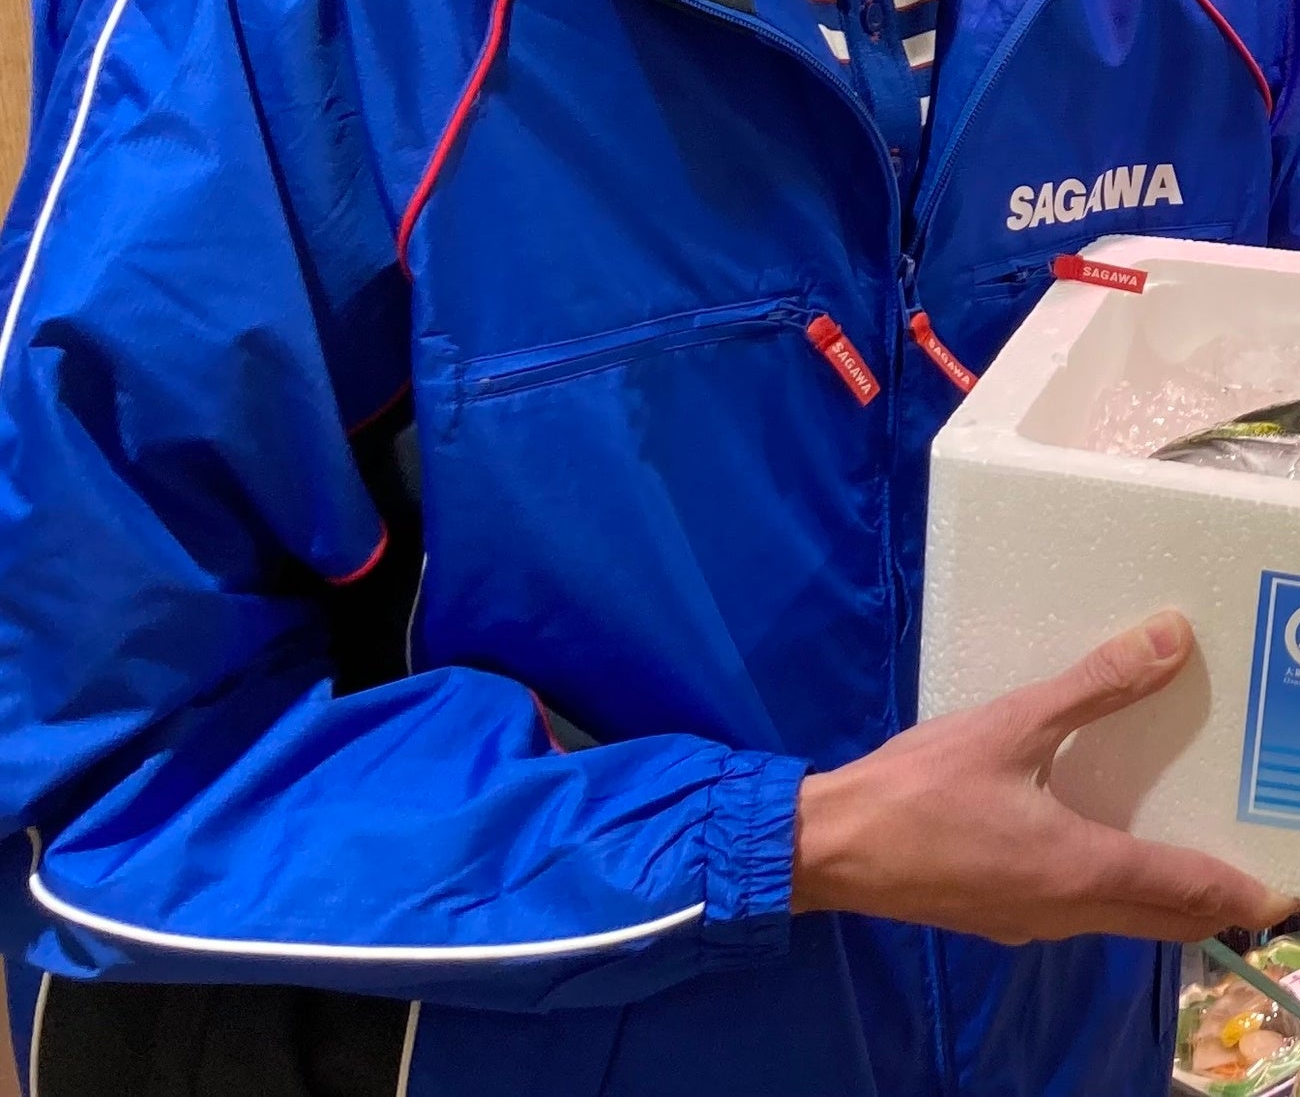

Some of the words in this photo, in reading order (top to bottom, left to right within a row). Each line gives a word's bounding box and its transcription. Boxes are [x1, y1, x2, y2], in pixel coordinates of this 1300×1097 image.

[1006, 163, 1183, 232] SAGAWA
[1082, 265, 1139, 287] SAGAWA
[831, 341, 872, 397] SAGAWA
[927, 337, 972, 387] SAGAWA
